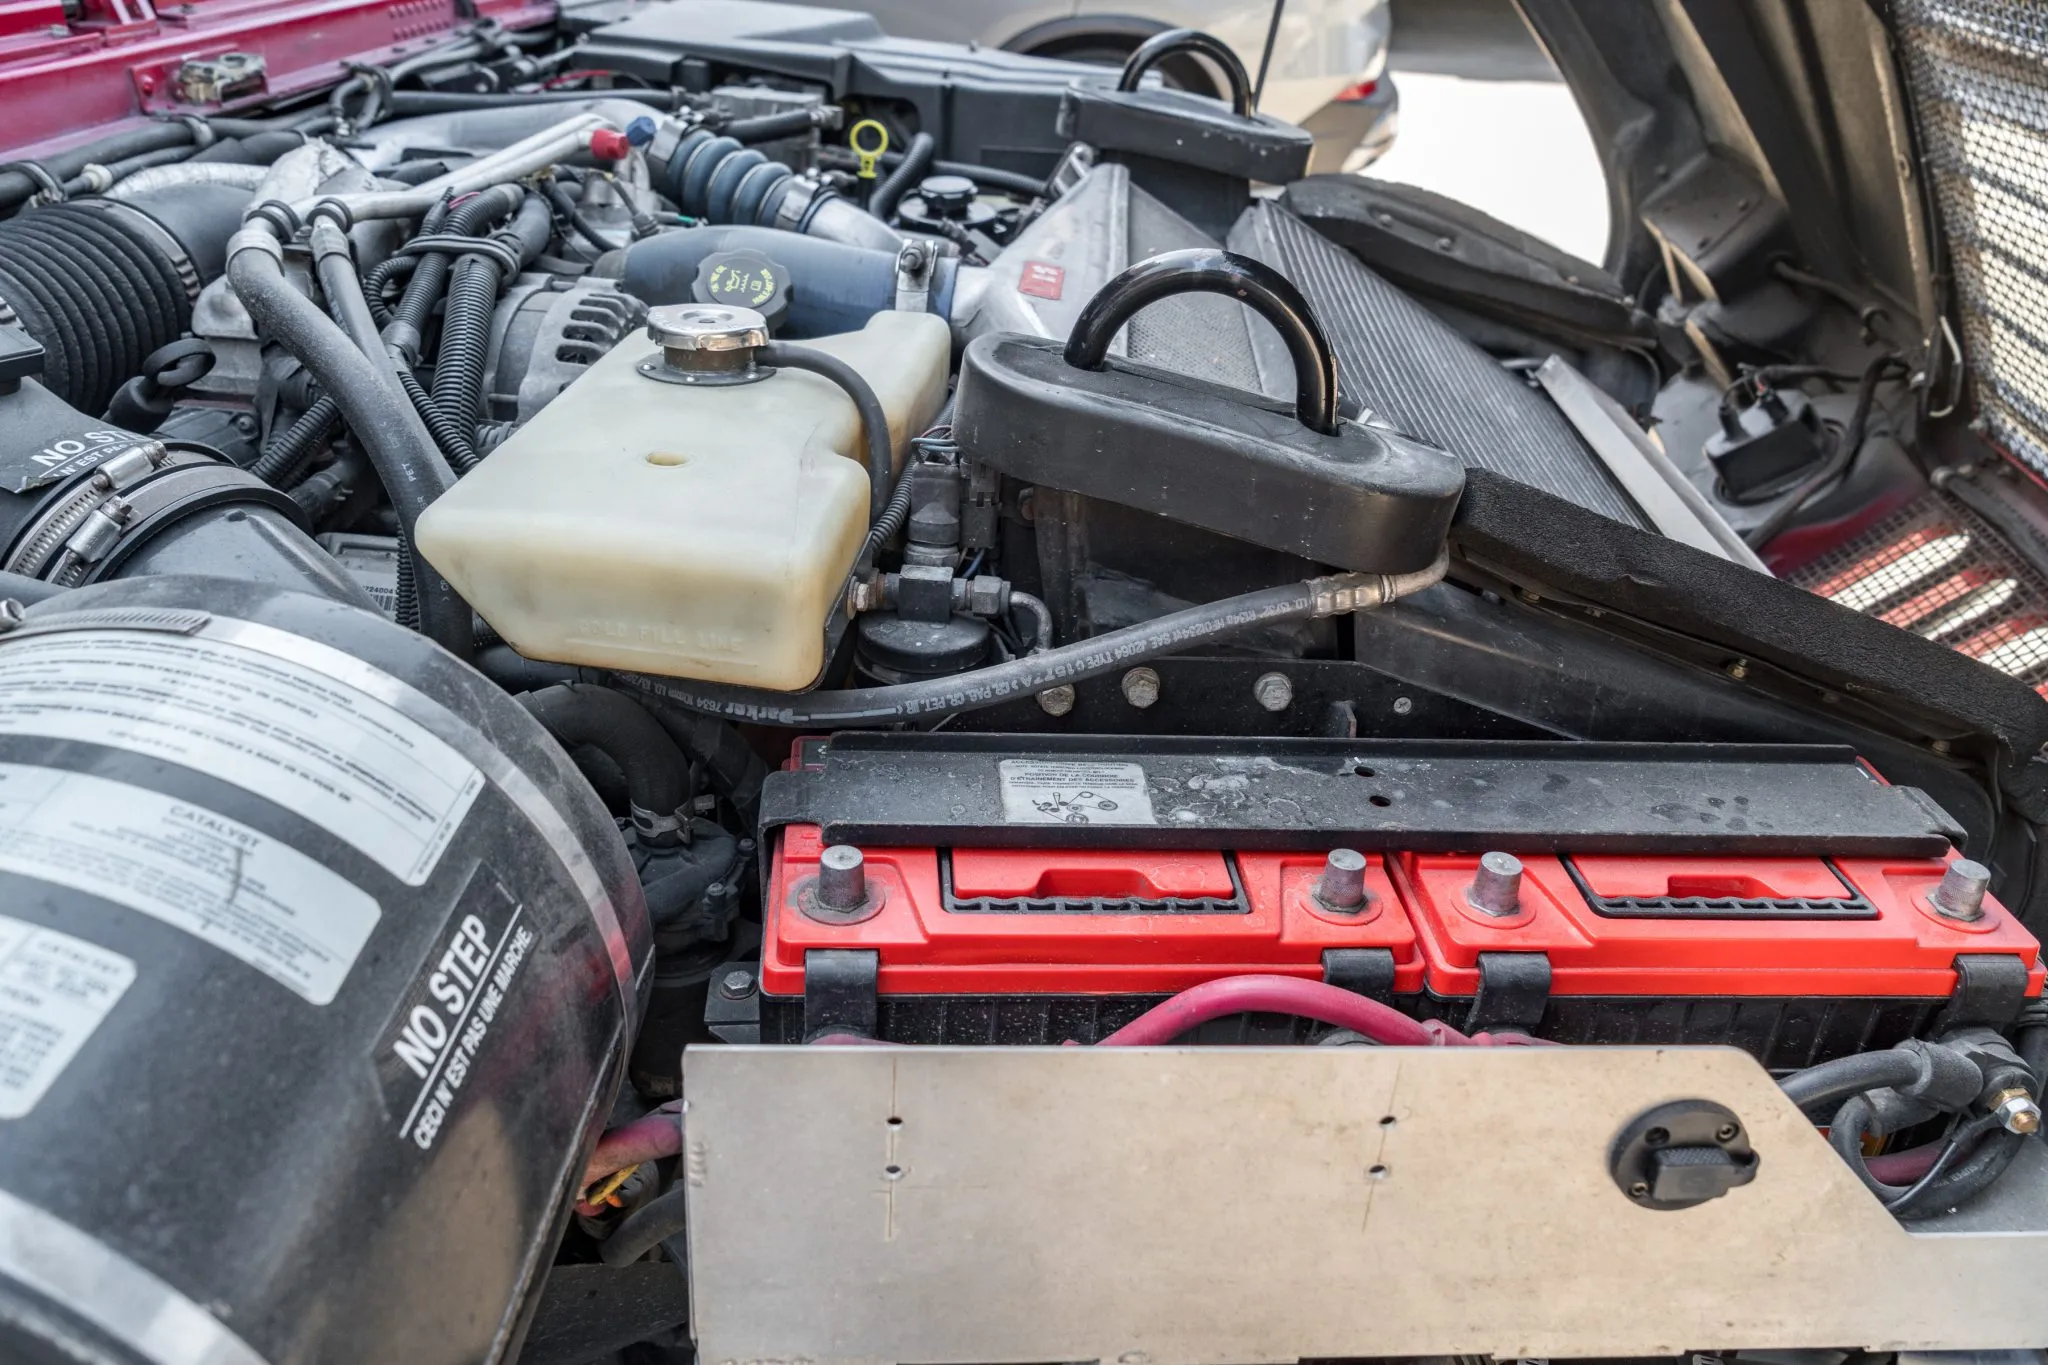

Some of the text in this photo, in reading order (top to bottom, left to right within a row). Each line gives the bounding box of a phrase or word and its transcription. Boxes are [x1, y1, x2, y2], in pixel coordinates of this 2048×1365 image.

[30, 439, 86, 467] NO
[76, 451, 104, 466] EST
[402, 462, 416, 482] PET
[1115, 640, 1148, 660] J2064
[1148, 632, 1171, 650] SAE
[1087, 651, 1114, 669] TYPE
[697, 697, 722, 713] 7634
[725, 701, 795, 724] Parker
[393, 1004, 447, 1079] NO
[429, 913, 491, 1015] STEP
[413, 1098, 446, 1150] CECI
[444, 1046, 471, 1089] EST
[461, 1016, 487, 1056] PAS
[477, 983, 503, 1023] UNE
